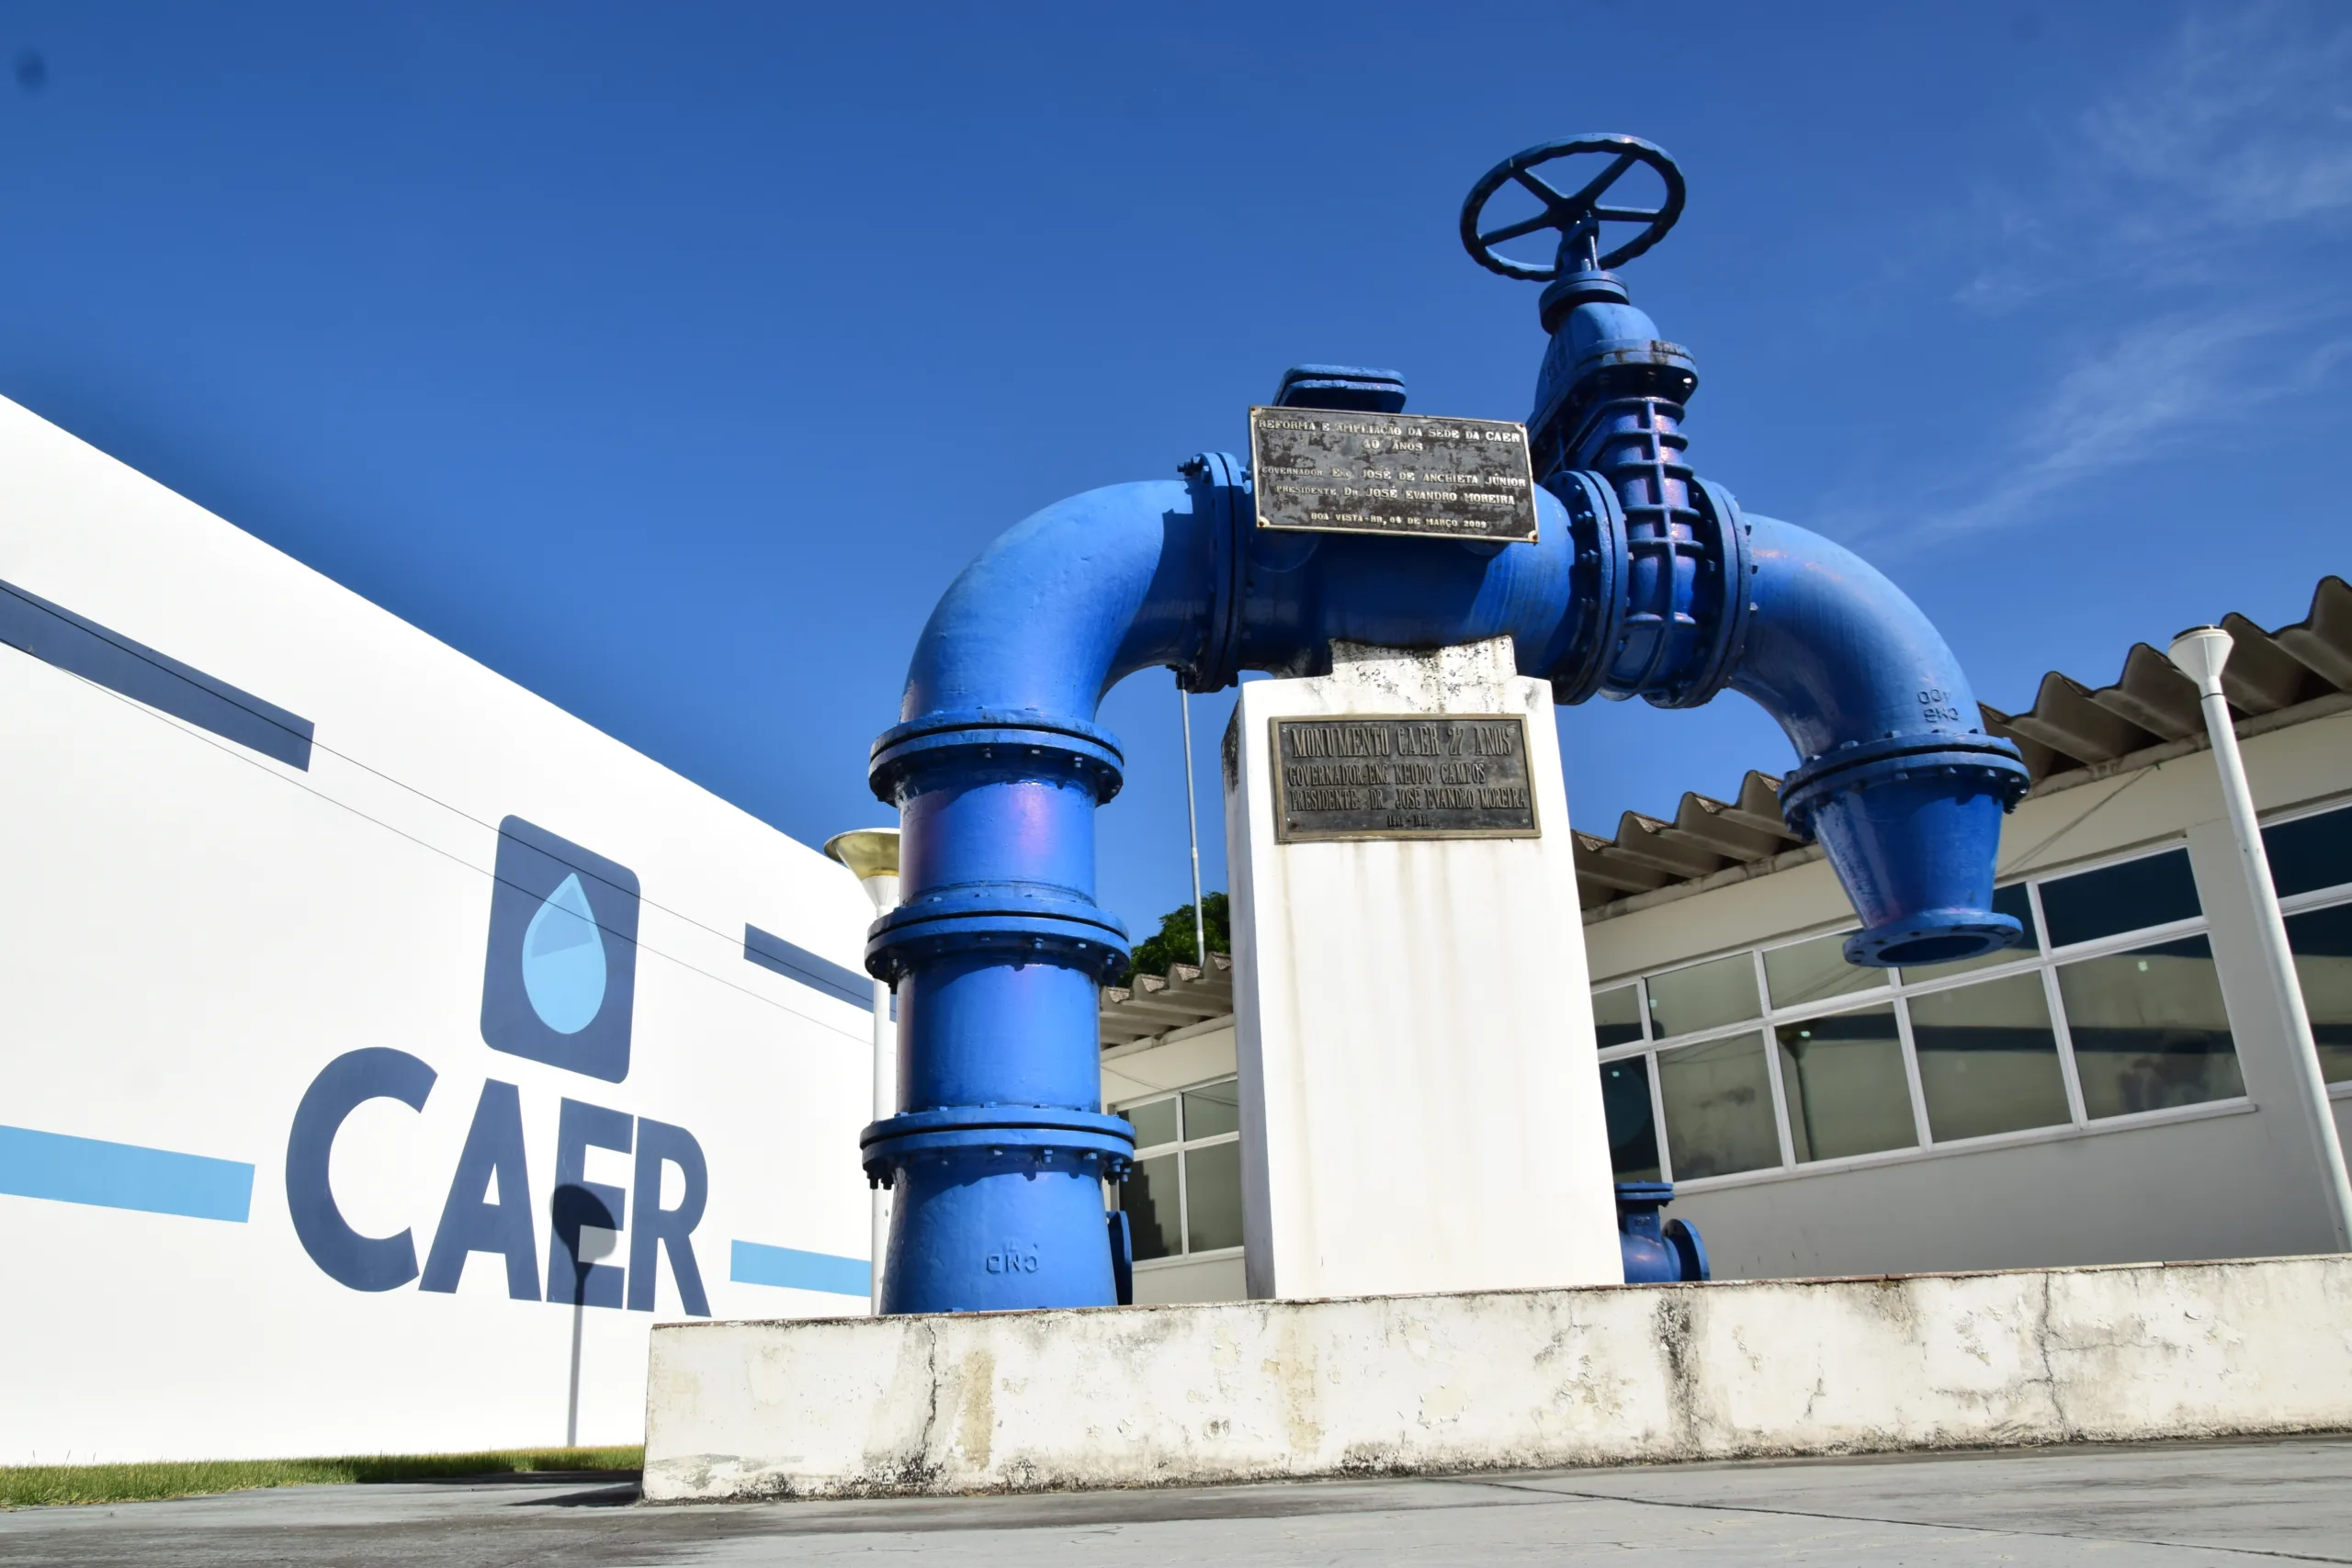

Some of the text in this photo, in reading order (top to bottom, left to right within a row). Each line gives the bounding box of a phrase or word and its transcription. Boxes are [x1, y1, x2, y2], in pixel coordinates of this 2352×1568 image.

[1258, 419, 1316, 432] REFORMA
[1322, 422, 1330, 432] E
[1408, 428, 1422, 437] DA
[1429, 429, 1459, 439] SEDE
[1465, 431, 1479, 441] DA
[1486, 431, 1521, 443] CAER
[1363, 439, 1423, 451] 40 ANOS
[1361, 468, 1391, 479] JOSÉ
[1398, 472, 1415, 481] DE
[1422, 473, 1478, 484] ANCHIETA
[1485, 473, 1526, 487] JÚNIOR
[1276, 485, 1337, 496] PRESIDENTE
[1367, 486, 1398, 499] JOSÉ
[1406, 491, 1457, 502] EVANDRO
[1463, 492, 1515, 505] MOREIRA
[1310, 513, 1329, 521] BOA
[1408, 516, 1420, 525] DE
[1426, 518, 1458, 528] MARÇO
[1463, 520, 1487, 528] 2009
[1291, 727, 1511, 757] MONUMENTO CAER 27 ANOS
[1394, 763, 1433, 784] NEUDO
[1441, 762, 1486, 784] CAMPOS
[1425, 787, 1475, 809] EVANDRO
[1479, 788, 1527, 809] MOREIRA
[286, 1046, 712, 1317] CAER
